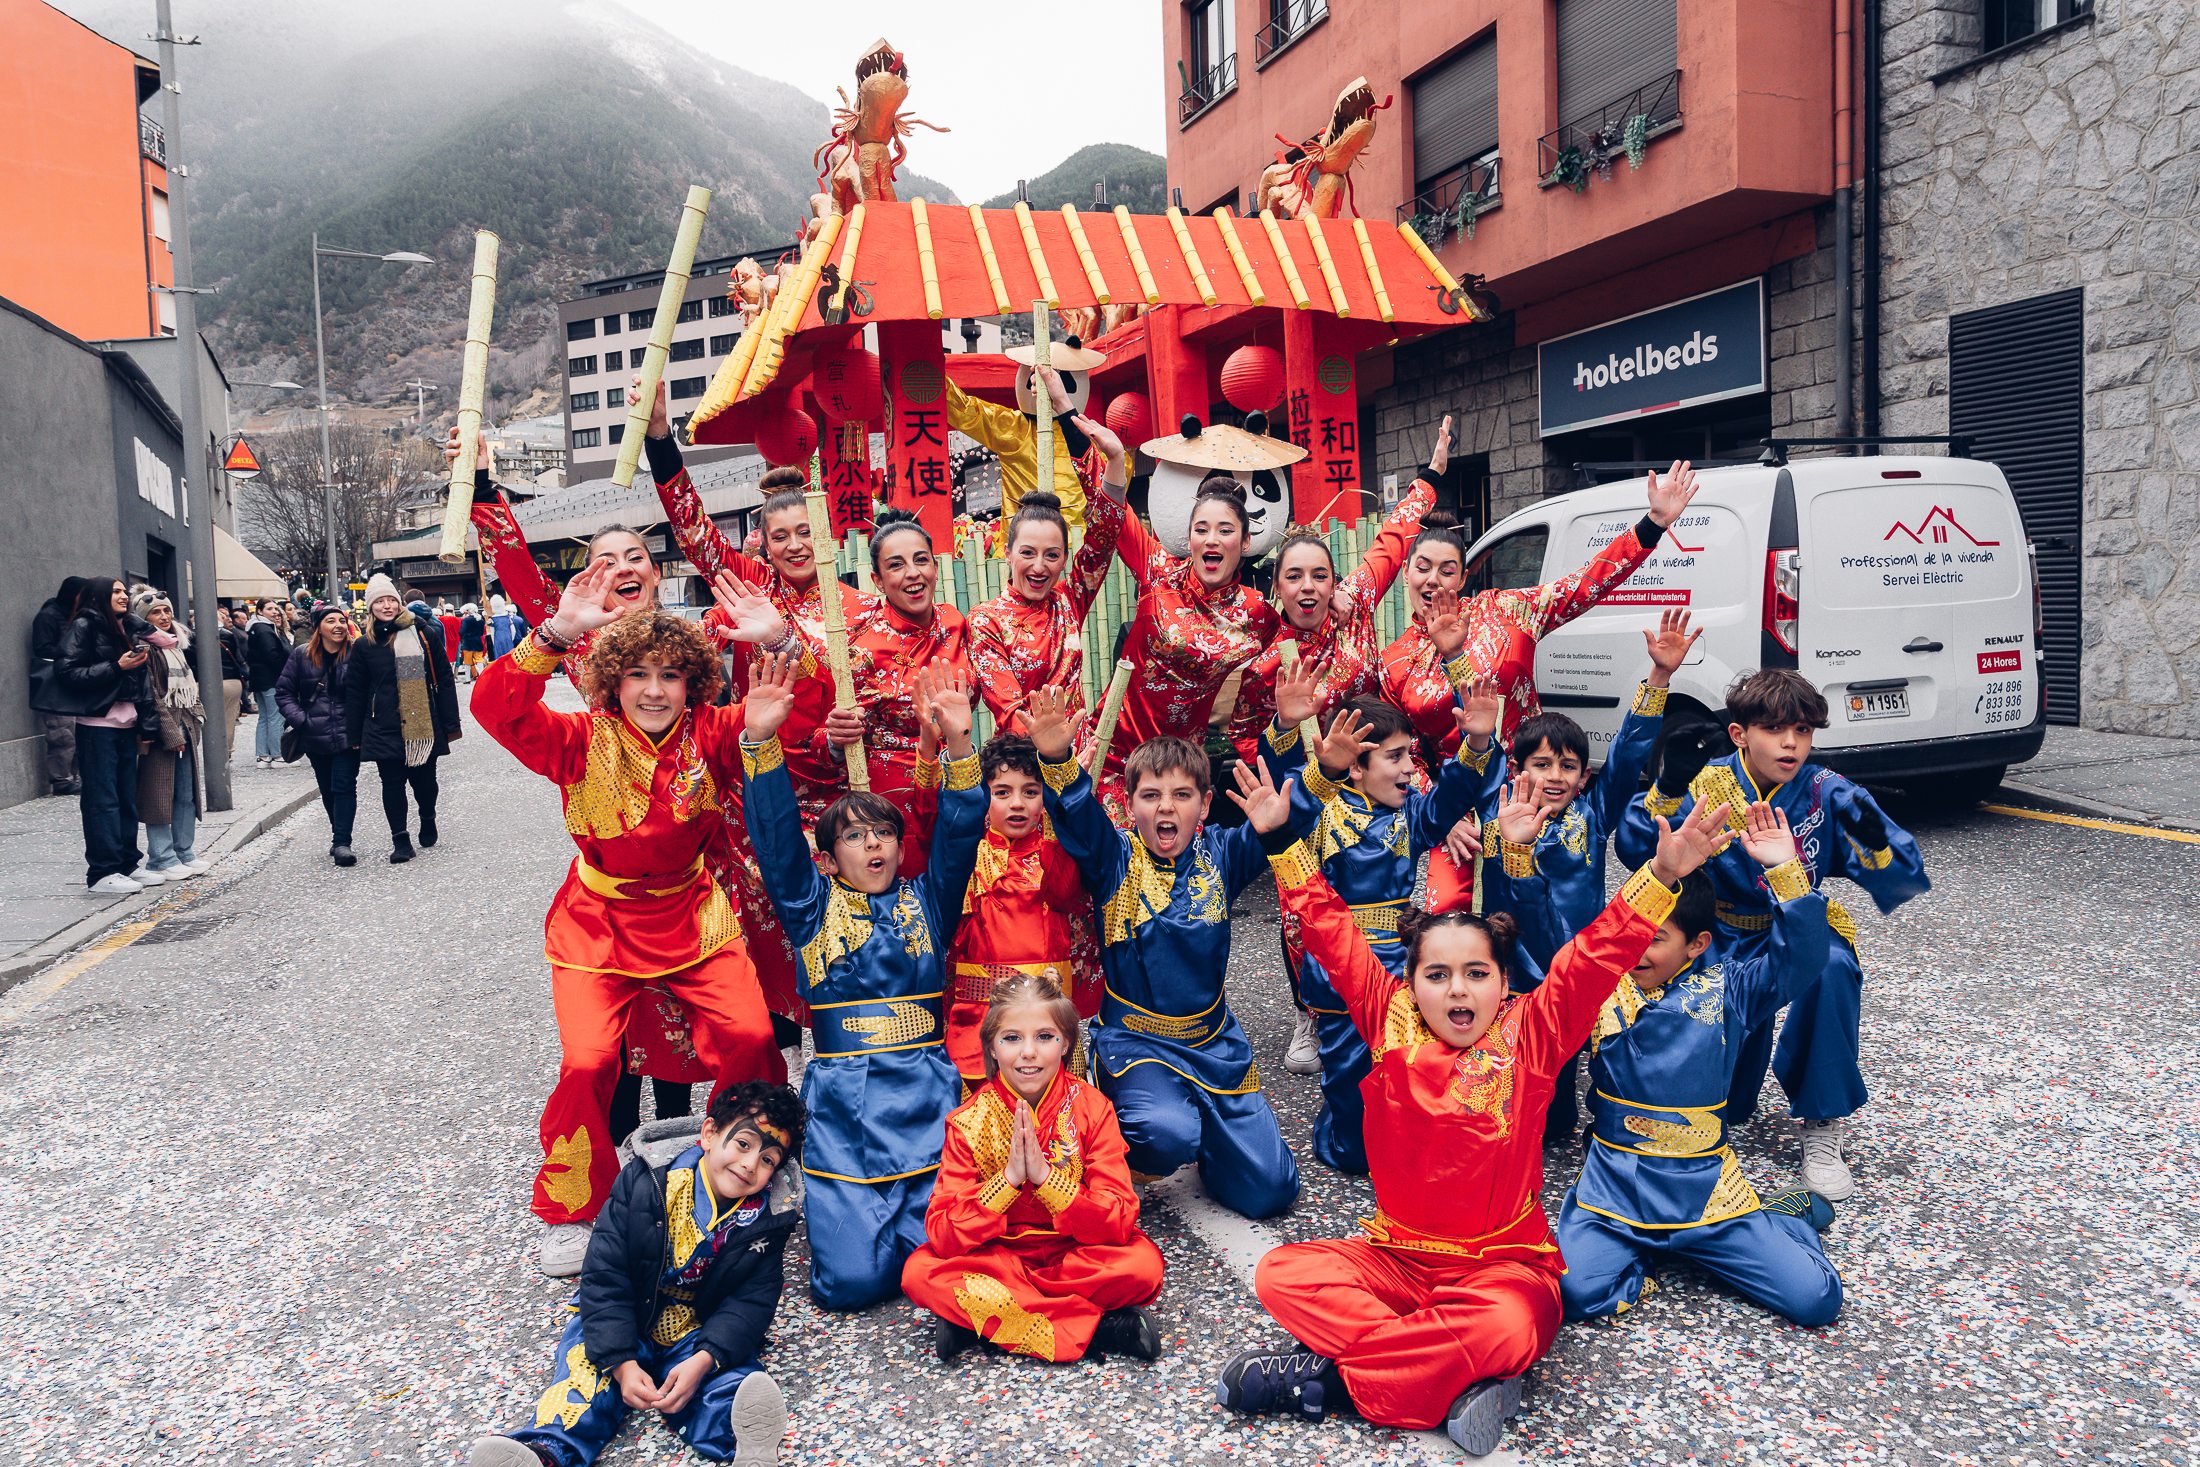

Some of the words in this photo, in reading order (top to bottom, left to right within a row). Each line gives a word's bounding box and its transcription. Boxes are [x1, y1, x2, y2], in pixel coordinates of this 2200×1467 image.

[1573, 330, 1718, 392] hotelbeds
[903, 410, 948, 498] 天使
[1320, 416, 1357, 493] 和平
[1602, 523, 1615, 533] 324
[1615, 522, 1628, 532] 896
[1679, 518, 1694, 528] 833
[1694, 516, 1711, 527] 936
[1649, 557, 1658, 569] la
[1662, 556, 1695, 568] vivenda
[1840, 552, 1918, 569] Professional
[1923, 551, 1937, 565] de
[1941, 552, 1953, 566] la
[1957, 549, 1995, 564] vivenda
[1632, 574, 1665, 586] Elèctric
[1882, 572, 1920, 586] Servei
[1923, 570, 1964, 585] Elèctric
[1615, 593, 1647, 602] electricitat
[1650, 592, 1686, 603] lampisteria
[1984, 634, 2024, 646] RENAULT
[1815, 649, 1862, 659] Kangoo
[1981, 657, 1993, 669] 24
[1993, 656, 2018, 668] Hores
[1986, 681, 2003, 694] 324
[2005, 680, 2022, 693] 896
[1877, 693, 1906, 711] 1961
[1985, 696, 2003, 710] 833
[2005, 695, 2022, 708] 936
[1984, 711, 2002, 724] 355
[2004, 709, 2021, 722] 680
